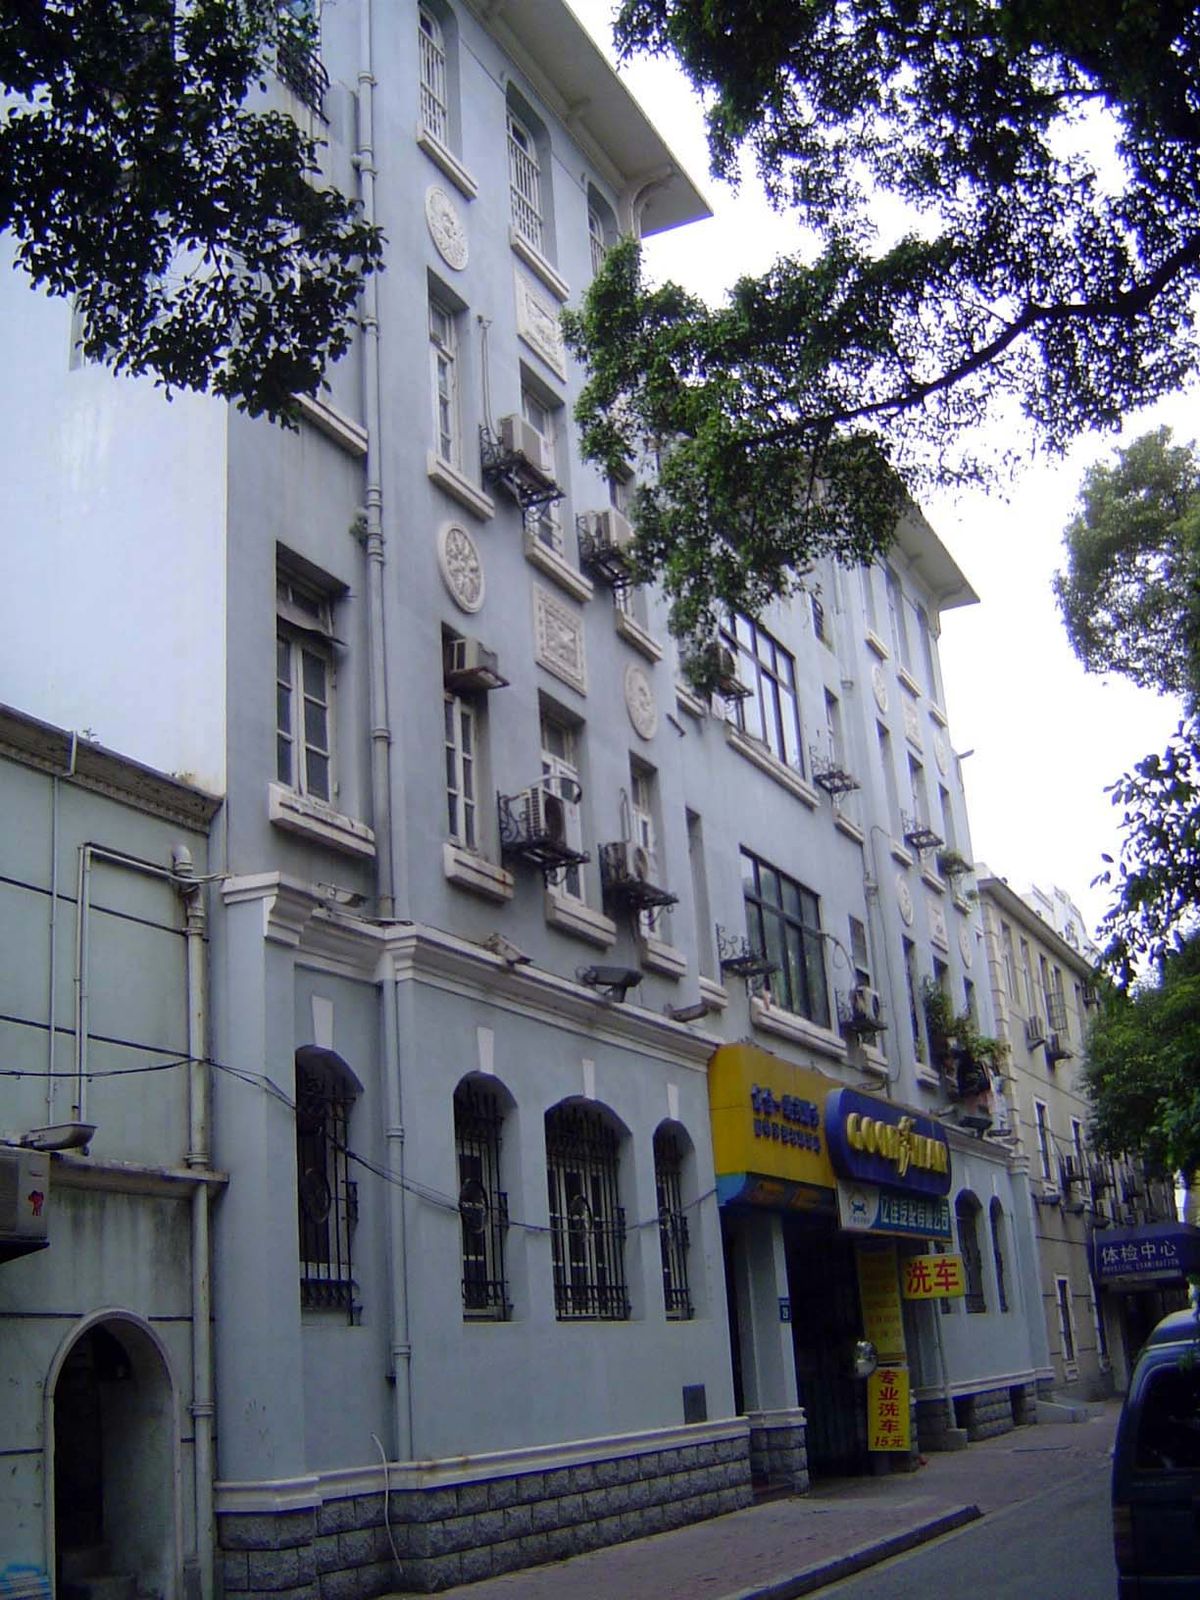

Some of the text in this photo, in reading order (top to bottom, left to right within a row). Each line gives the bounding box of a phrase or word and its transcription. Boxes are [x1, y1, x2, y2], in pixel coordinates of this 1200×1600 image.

[1102, 1240, 1176, 1264] 体检中心
[906, 1259, 959, 1293] 洗车
[877, 1370, 900, 1433] 专业洗车
[875, 1436, 903, 1448] 15元
